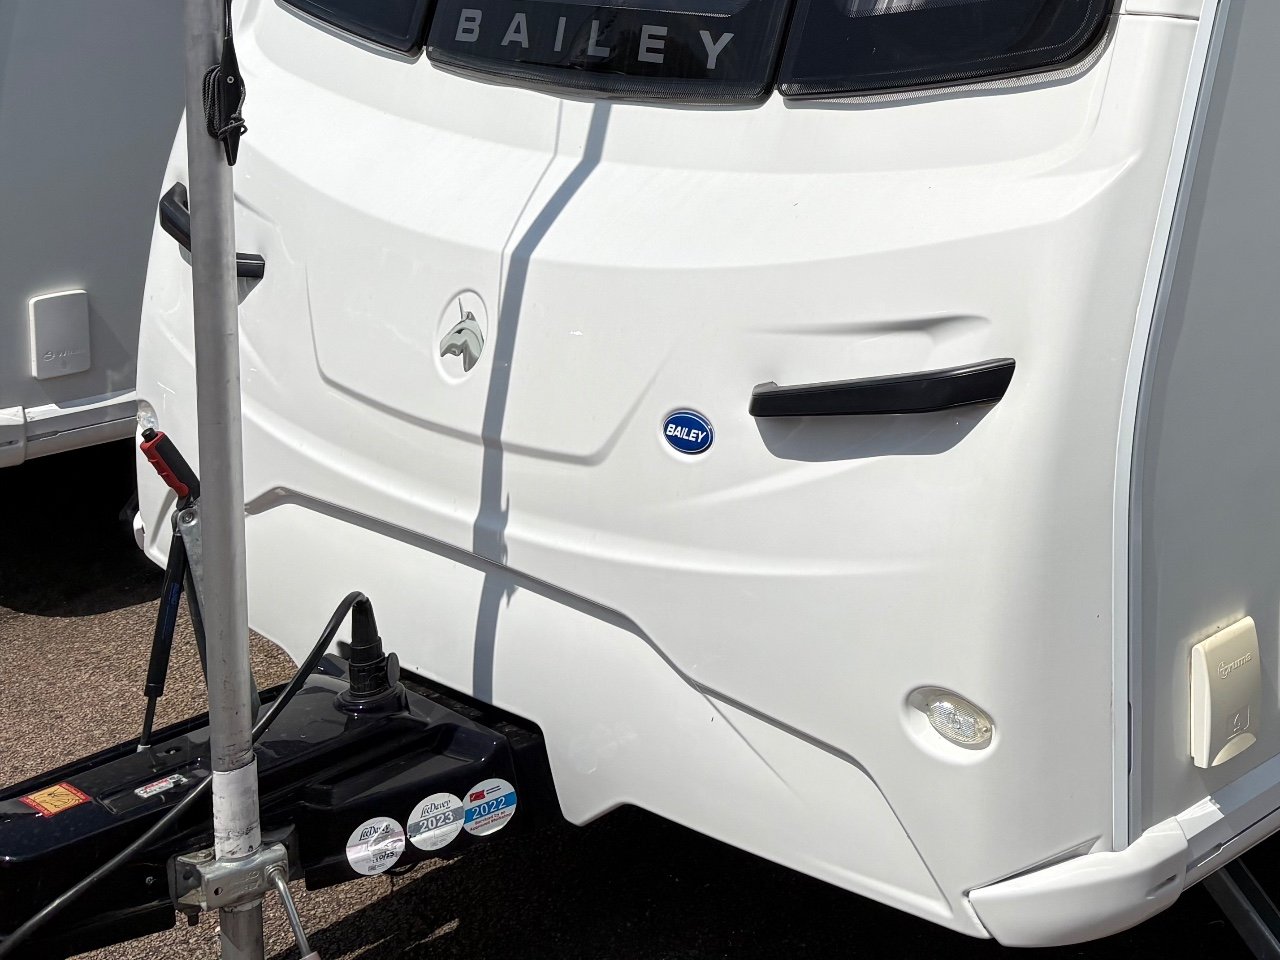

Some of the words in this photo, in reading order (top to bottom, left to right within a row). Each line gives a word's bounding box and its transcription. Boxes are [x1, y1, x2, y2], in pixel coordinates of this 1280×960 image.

[455, 8, 735, 69] BAILEY
[666, 423, 707, 442] BAILEY
[472, 796, 507, 819] 2022
[420, 811, 454, 833] 2023
